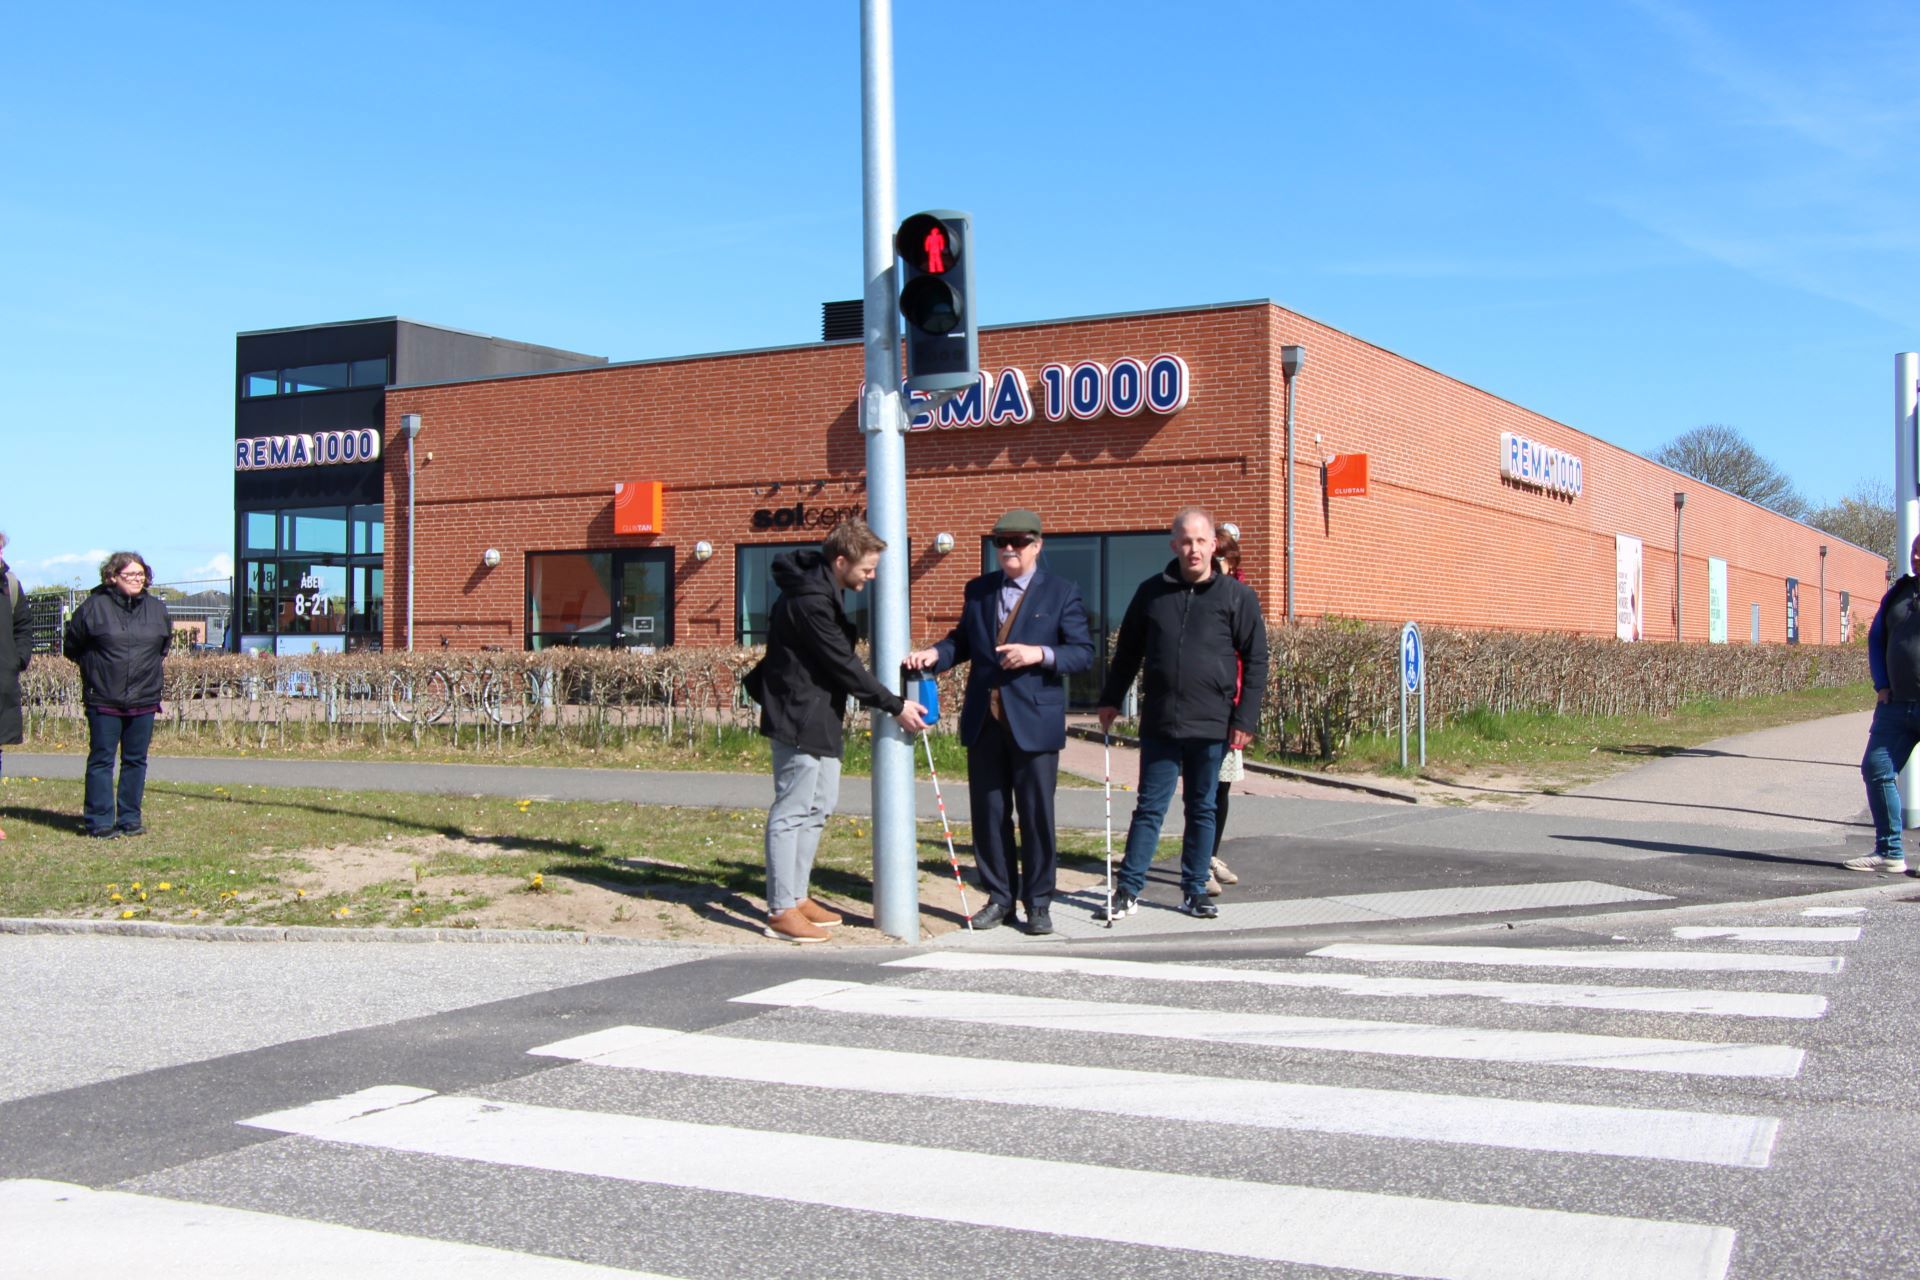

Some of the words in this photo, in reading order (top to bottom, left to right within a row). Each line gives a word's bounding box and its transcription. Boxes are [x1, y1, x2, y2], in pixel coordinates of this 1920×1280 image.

[1040, 353, 1176, 421] 1000
[236, 433, 310, 471] REMA
[313, 429, 375, 465] 1000
[1508, 434, 1553, 489] REMA
[1553, 448, 1583, 498] 1000
[295, 593, 329, 616] 8-21
